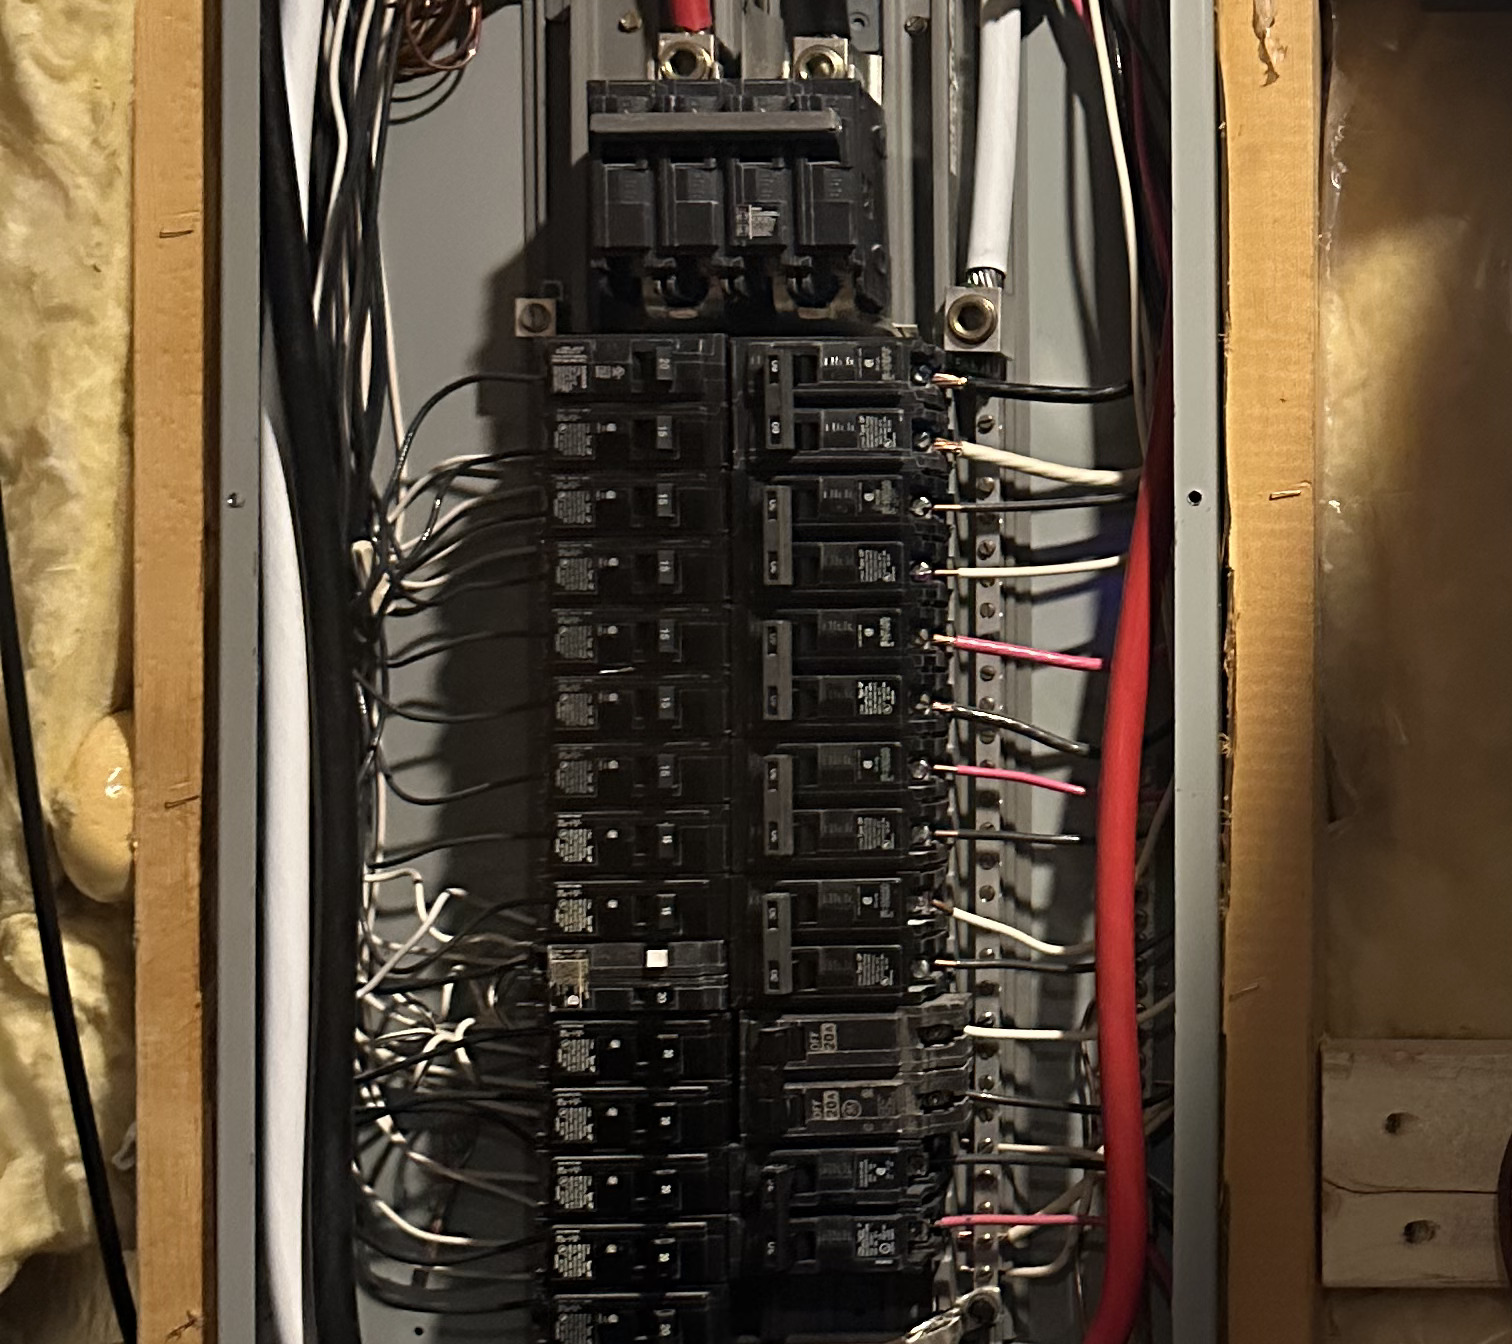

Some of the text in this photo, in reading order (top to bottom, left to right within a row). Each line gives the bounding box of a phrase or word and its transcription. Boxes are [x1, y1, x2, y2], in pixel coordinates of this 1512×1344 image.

[809, 1031, 820, 1050] OFF
[823, 1026, 835, 1049] 20A
[812, 1099, 822, 1120] OFF
[826, 1094, 838, 1118] 20A
